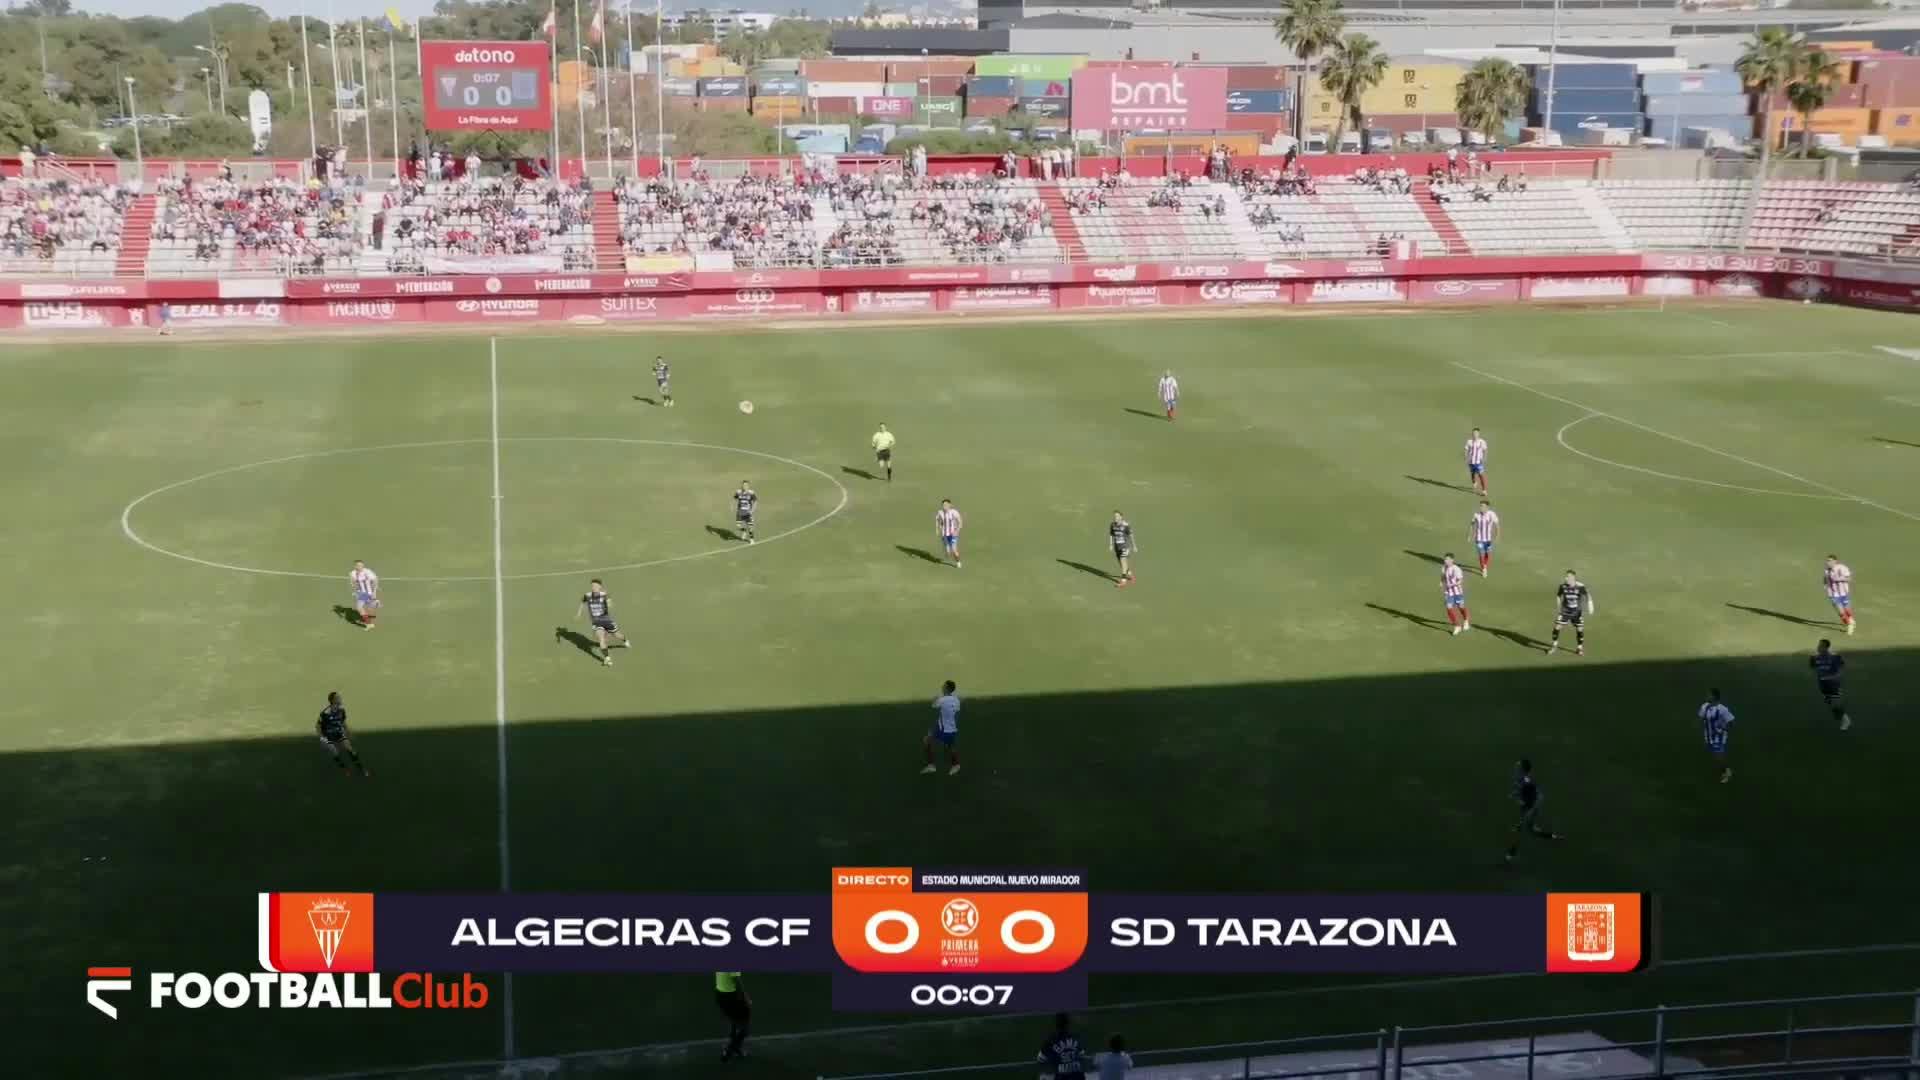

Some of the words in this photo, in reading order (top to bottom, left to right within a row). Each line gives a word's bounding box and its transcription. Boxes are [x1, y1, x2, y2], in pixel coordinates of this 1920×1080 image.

[455, 48, 515, 63] datono
[463, 86, 480, 106] 0
[495, 86, 512, 106] 0
[1111, 72, 1188, 104] bmt
[871, 99, 902, 112] ONE
